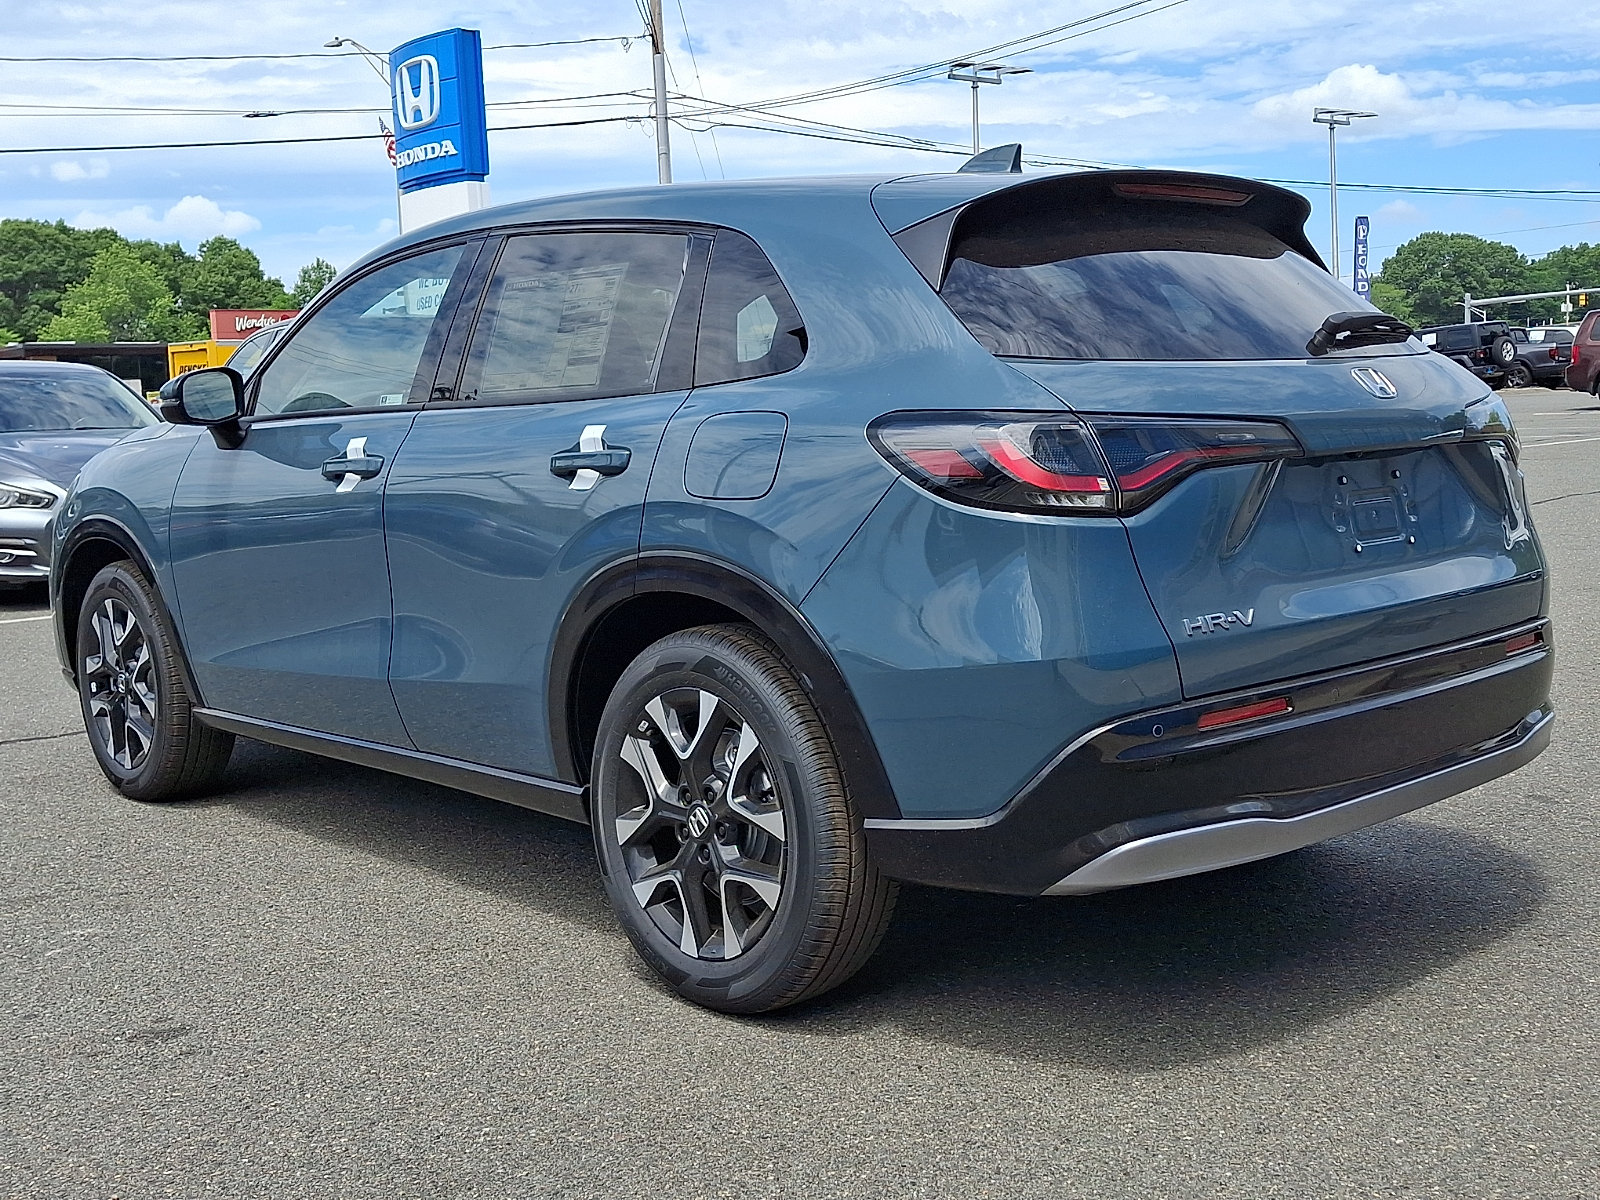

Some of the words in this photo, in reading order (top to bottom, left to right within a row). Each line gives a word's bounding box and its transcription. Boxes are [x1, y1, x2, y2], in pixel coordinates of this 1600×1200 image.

[396, 140, 459, 168] HONDA
[417, 296, 433, 311] USED
[235, 314, 276, 331] Wendy's
[1182, 608, 1255, 636] HR-V
